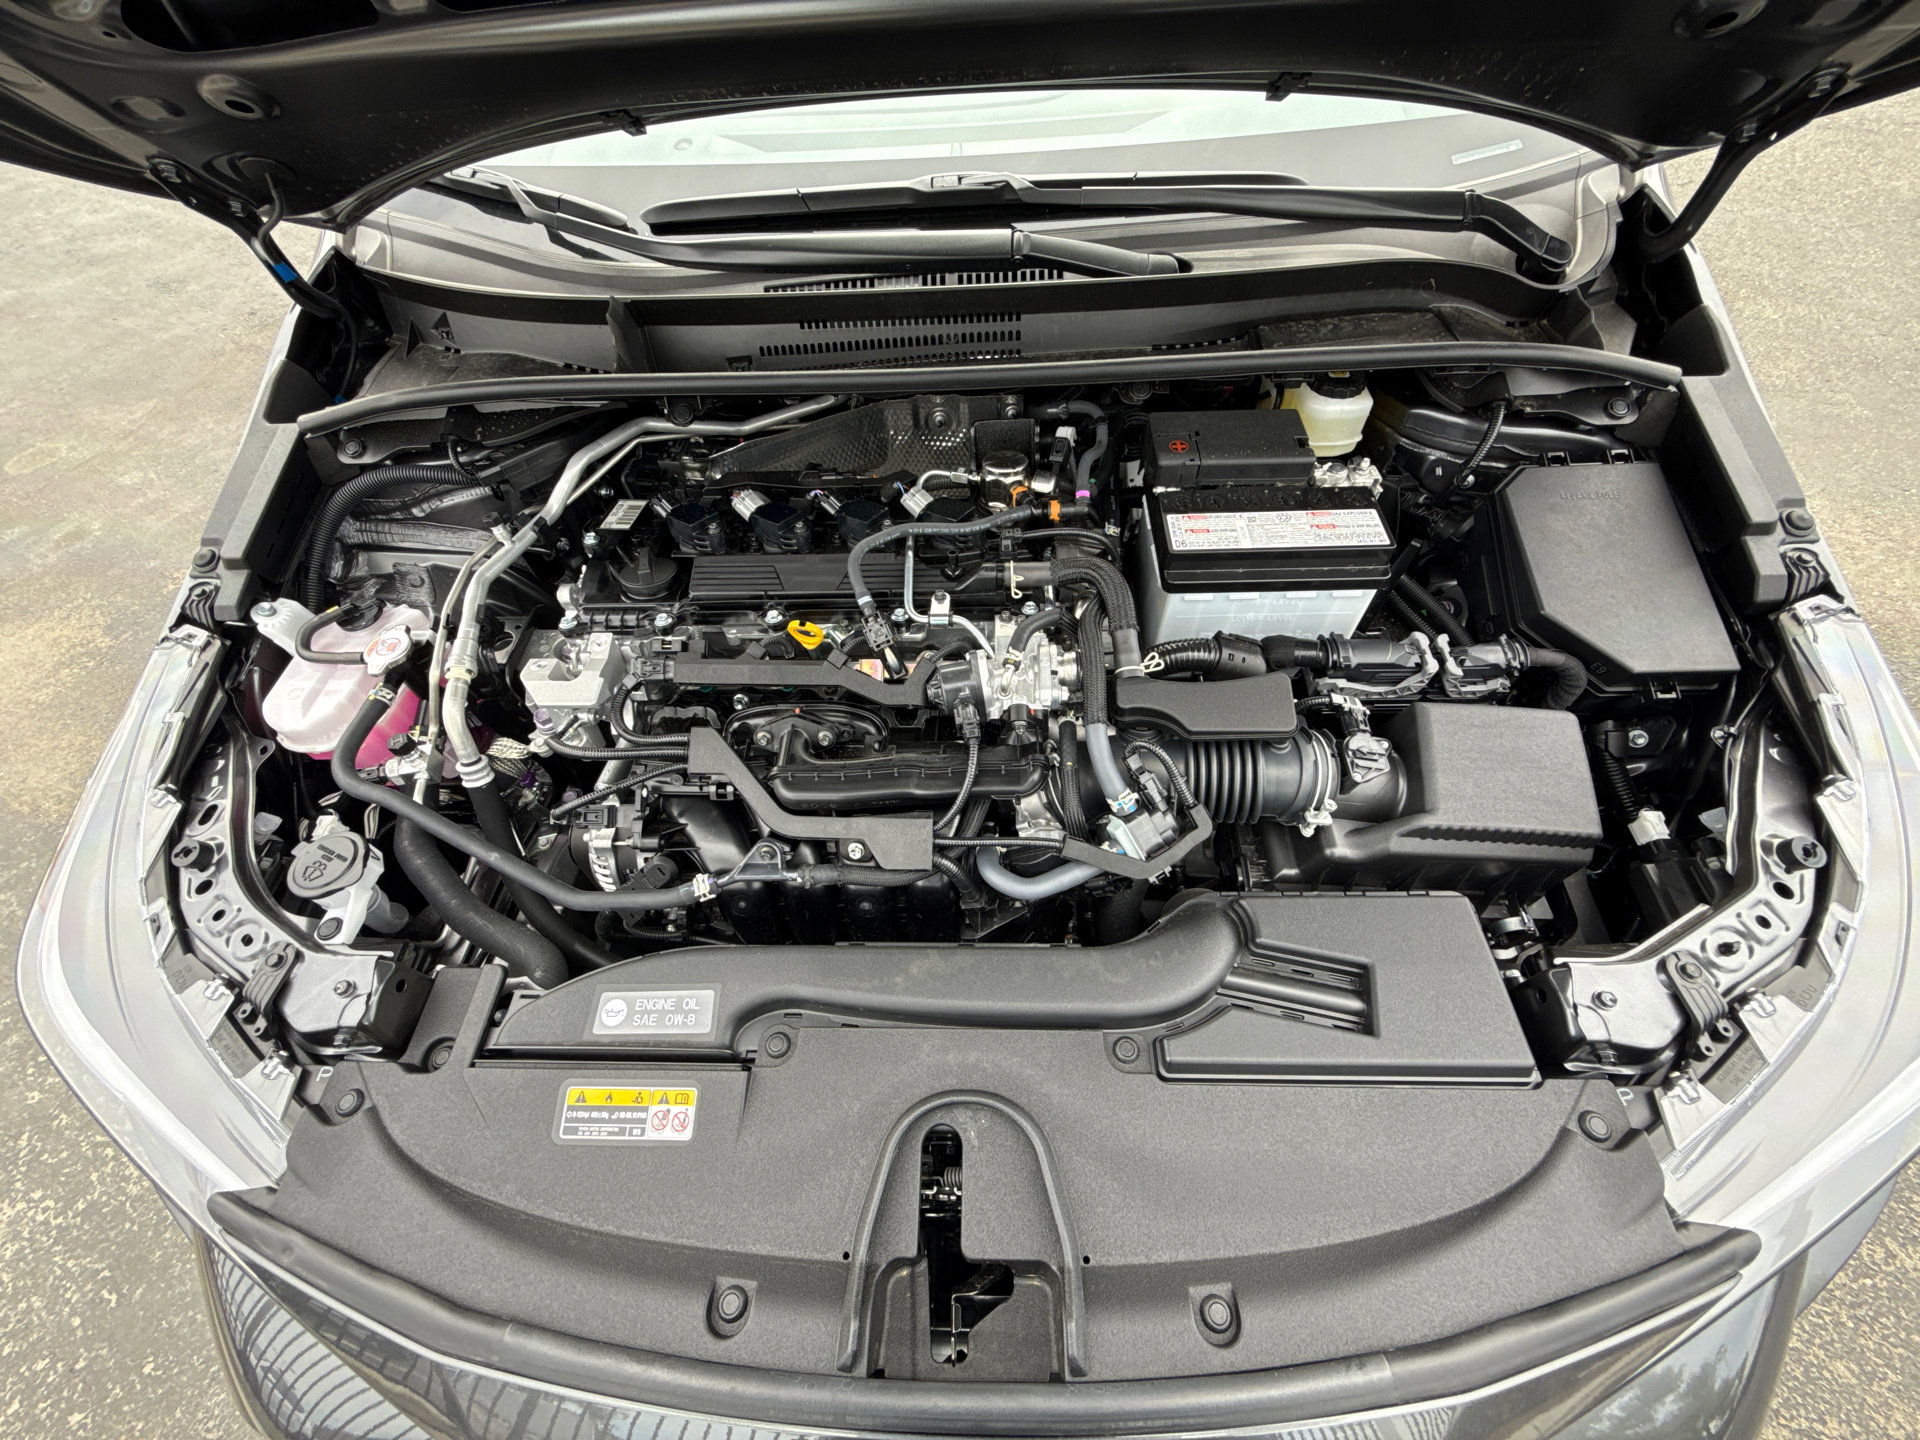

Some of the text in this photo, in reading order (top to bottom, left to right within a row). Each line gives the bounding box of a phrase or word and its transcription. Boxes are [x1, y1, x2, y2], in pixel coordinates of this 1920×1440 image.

[635, 998, 700, 1011] ENGINE OIL
[632, 1013, 658, 1026] SAE
